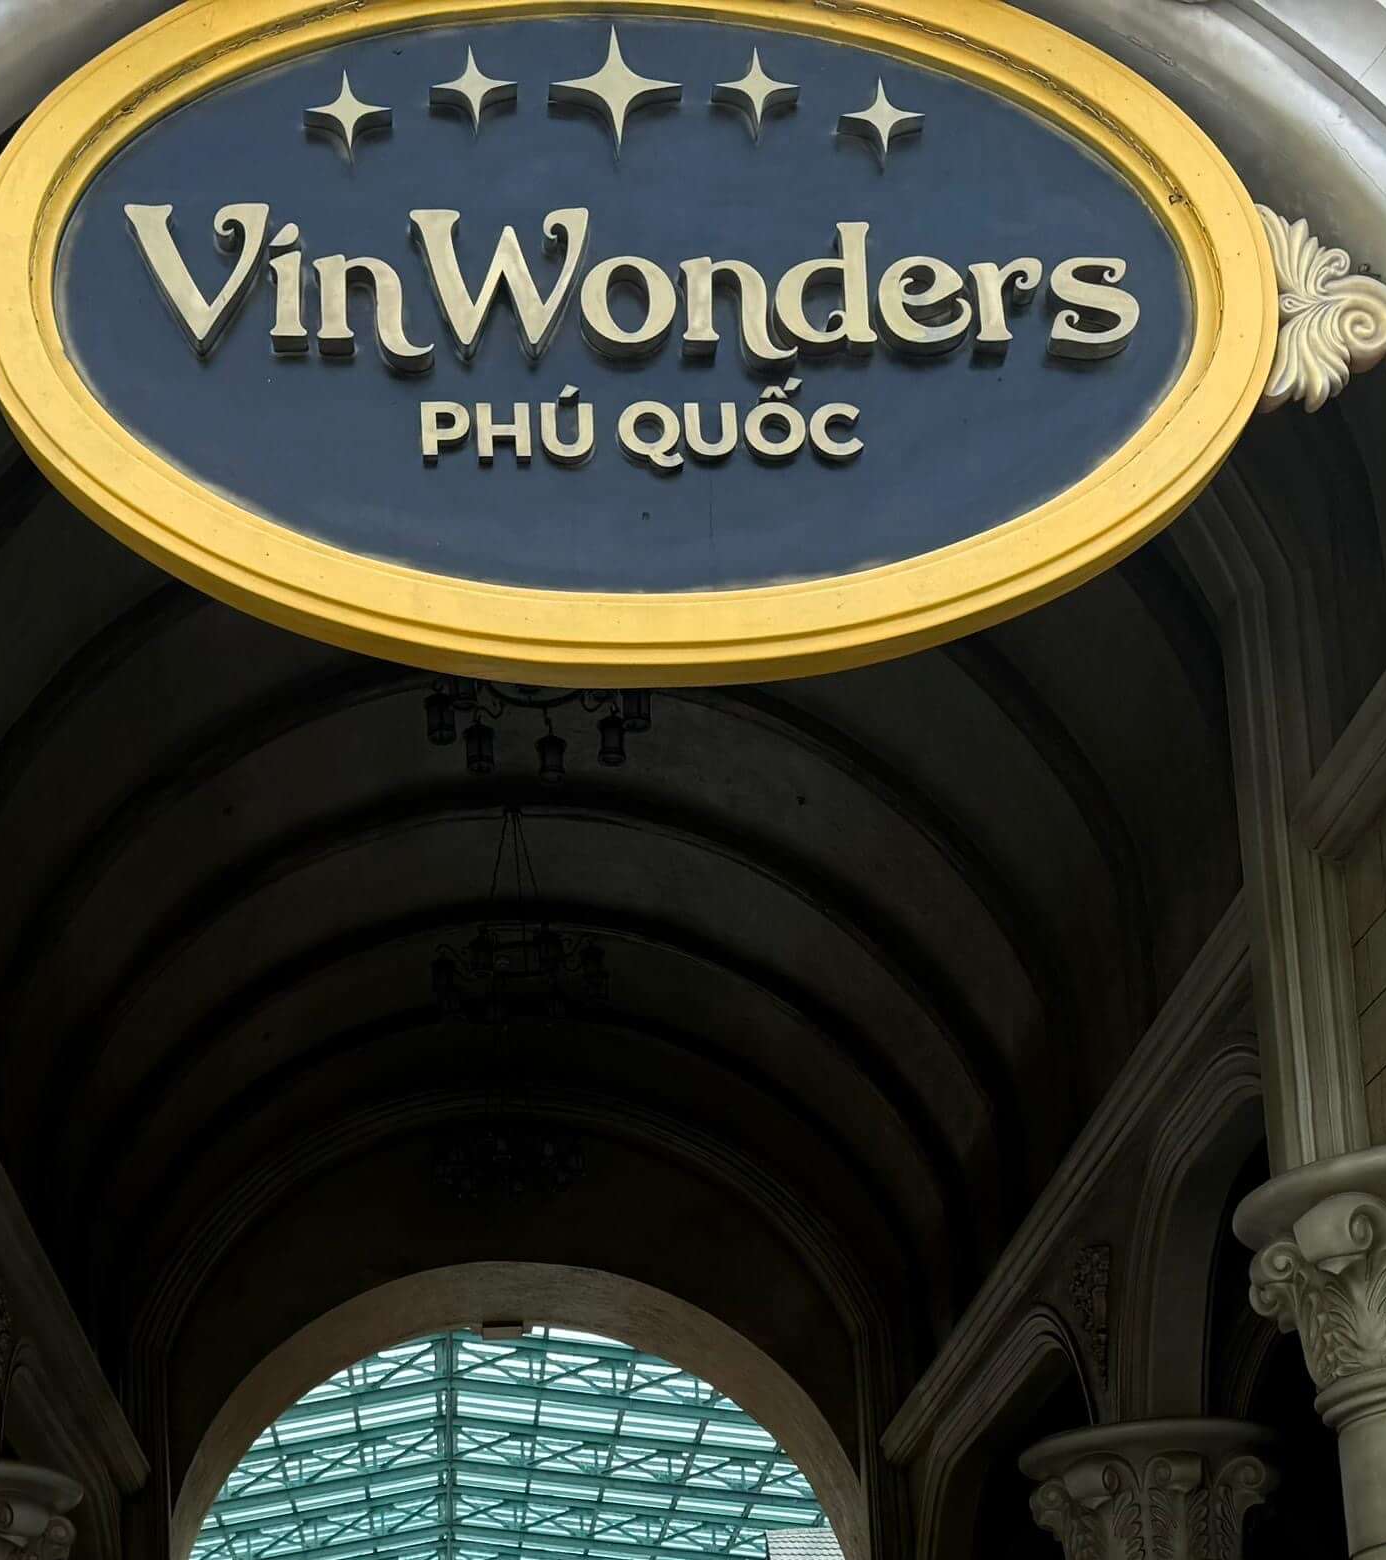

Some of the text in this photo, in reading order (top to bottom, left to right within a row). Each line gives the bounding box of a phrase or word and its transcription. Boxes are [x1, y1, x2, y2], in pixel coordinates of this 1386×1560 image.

[124, 203, 1143, 373] VinWonders
[420, 378, 866, 473] PHÚ QUỐC
